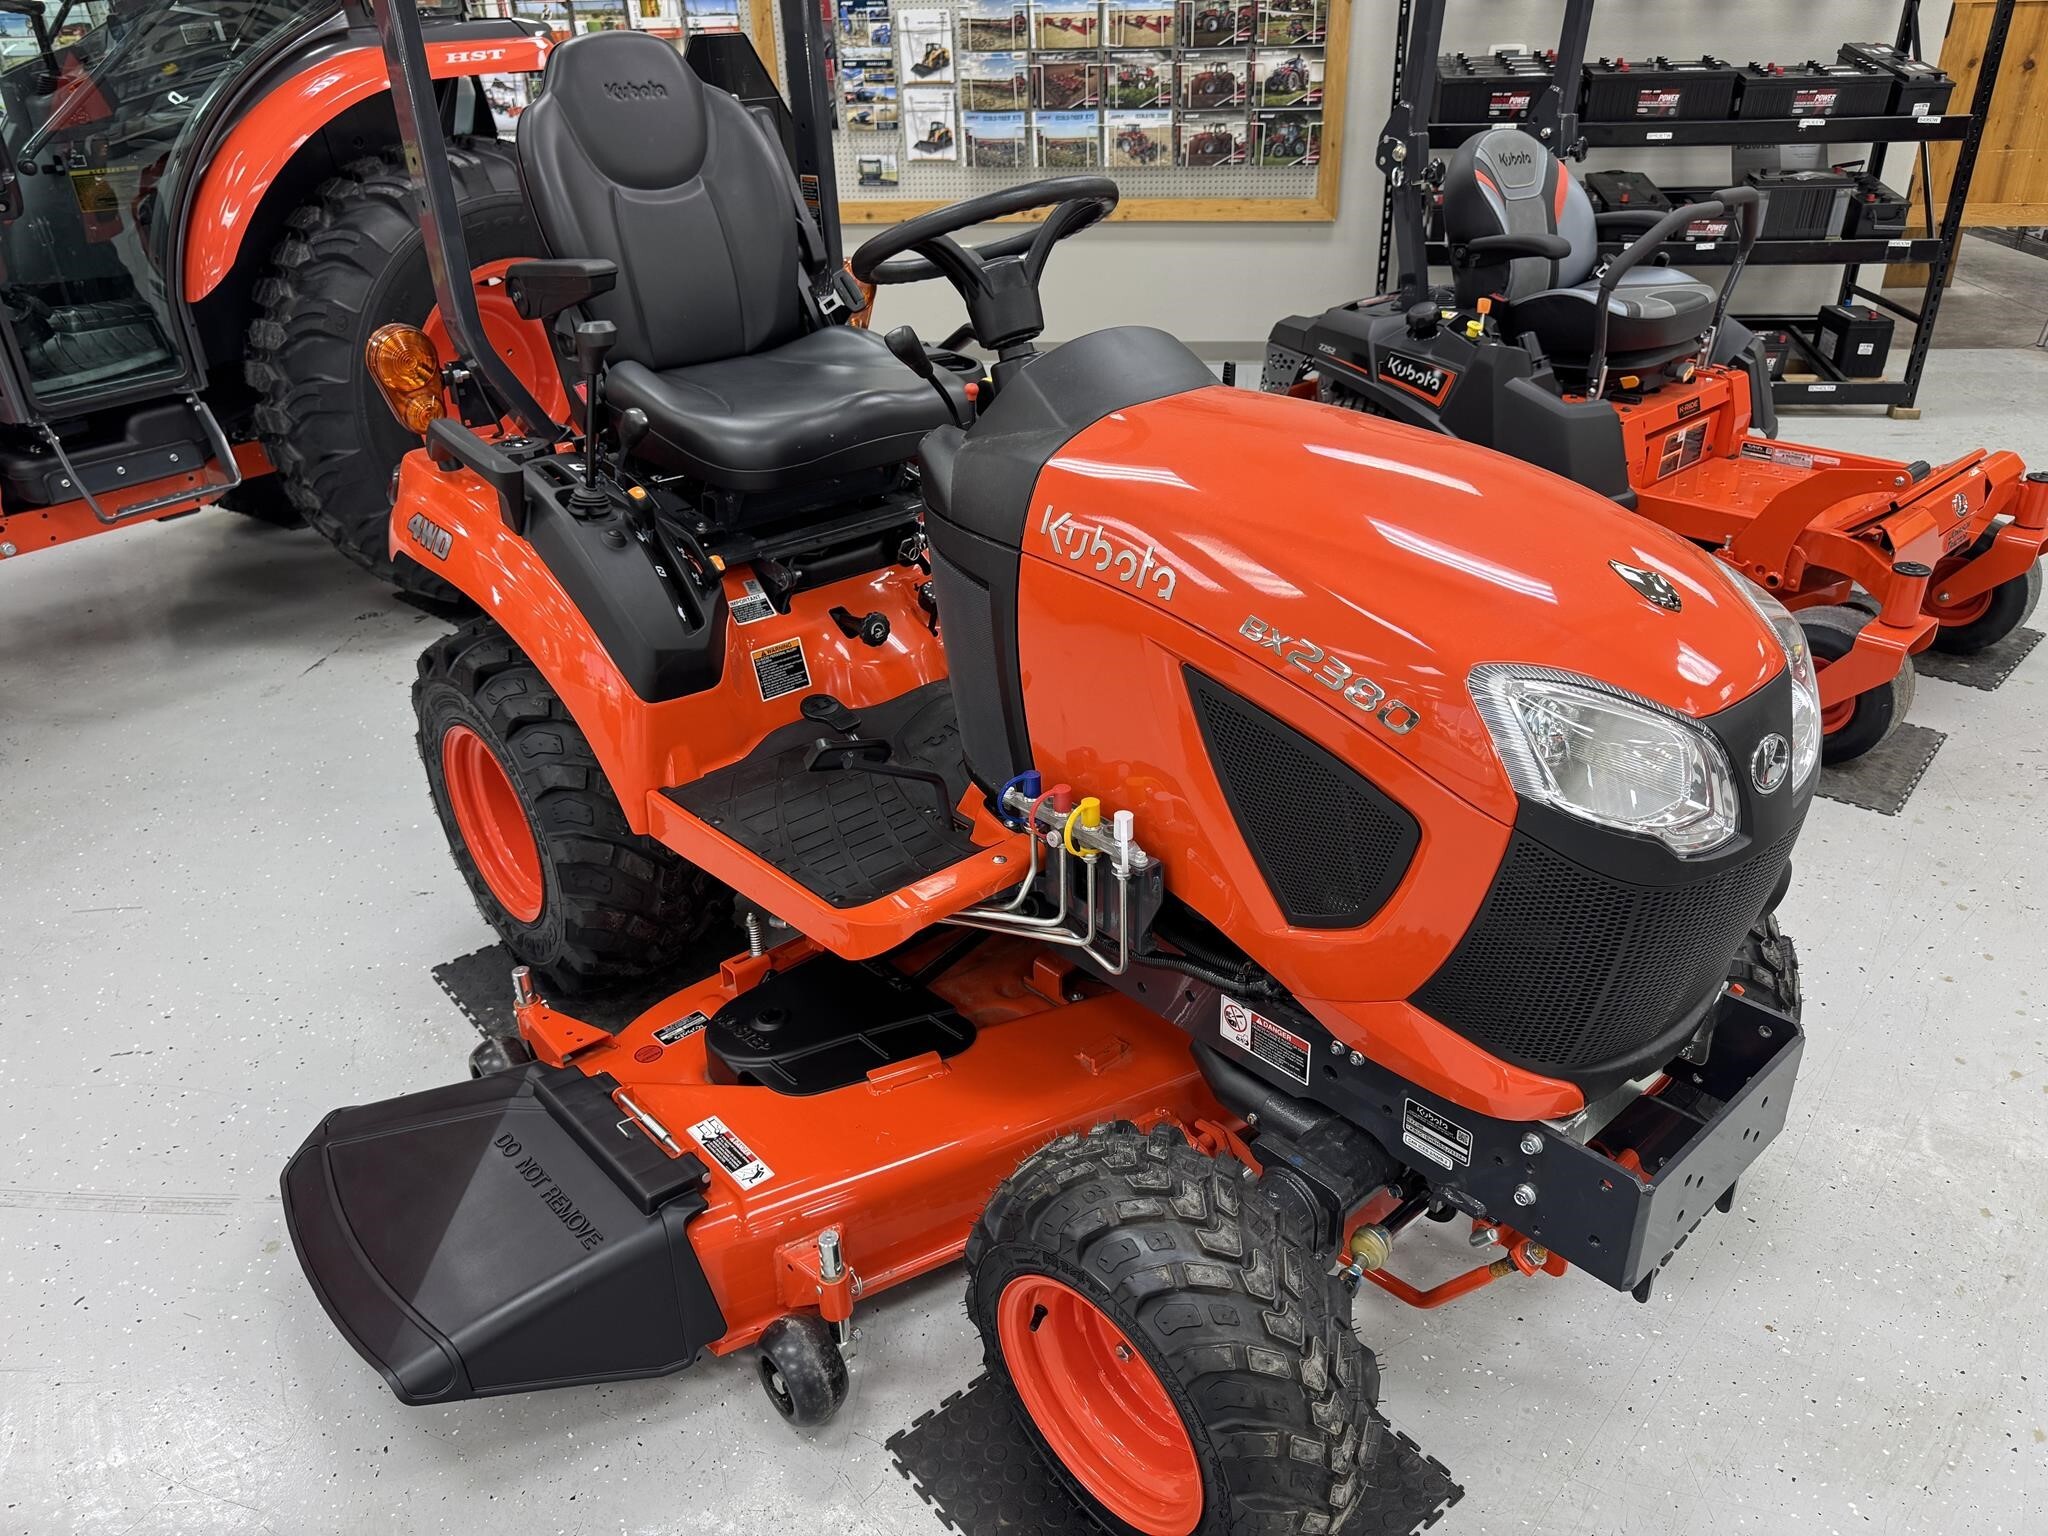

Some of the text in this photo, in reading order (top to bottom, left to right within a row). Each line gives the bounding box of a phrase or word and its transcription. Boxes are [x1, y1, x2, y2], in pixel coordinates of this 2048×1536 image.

[446, 48, 506, 64] HST
[603, 79, 668, 102] Kubota
[1498, 151, 1532, 167] Kubota
[1387, 357, 1441, 391] Kubota
[407, 511, 454, 561] 4WD
[1040, 504, 1177, 602] Kubota
[730, 595, 761, 607] IMPORTANT
[767, 642, 792, 654] WARNING
[1238, 613, 1422, 736] BX2380
[1263, 1021, 1292, 1042] DANGER
[1416, 1106, 1449, 1130] Kubota
[494, 1131, 604, 1251] DO NOT REMOVE
